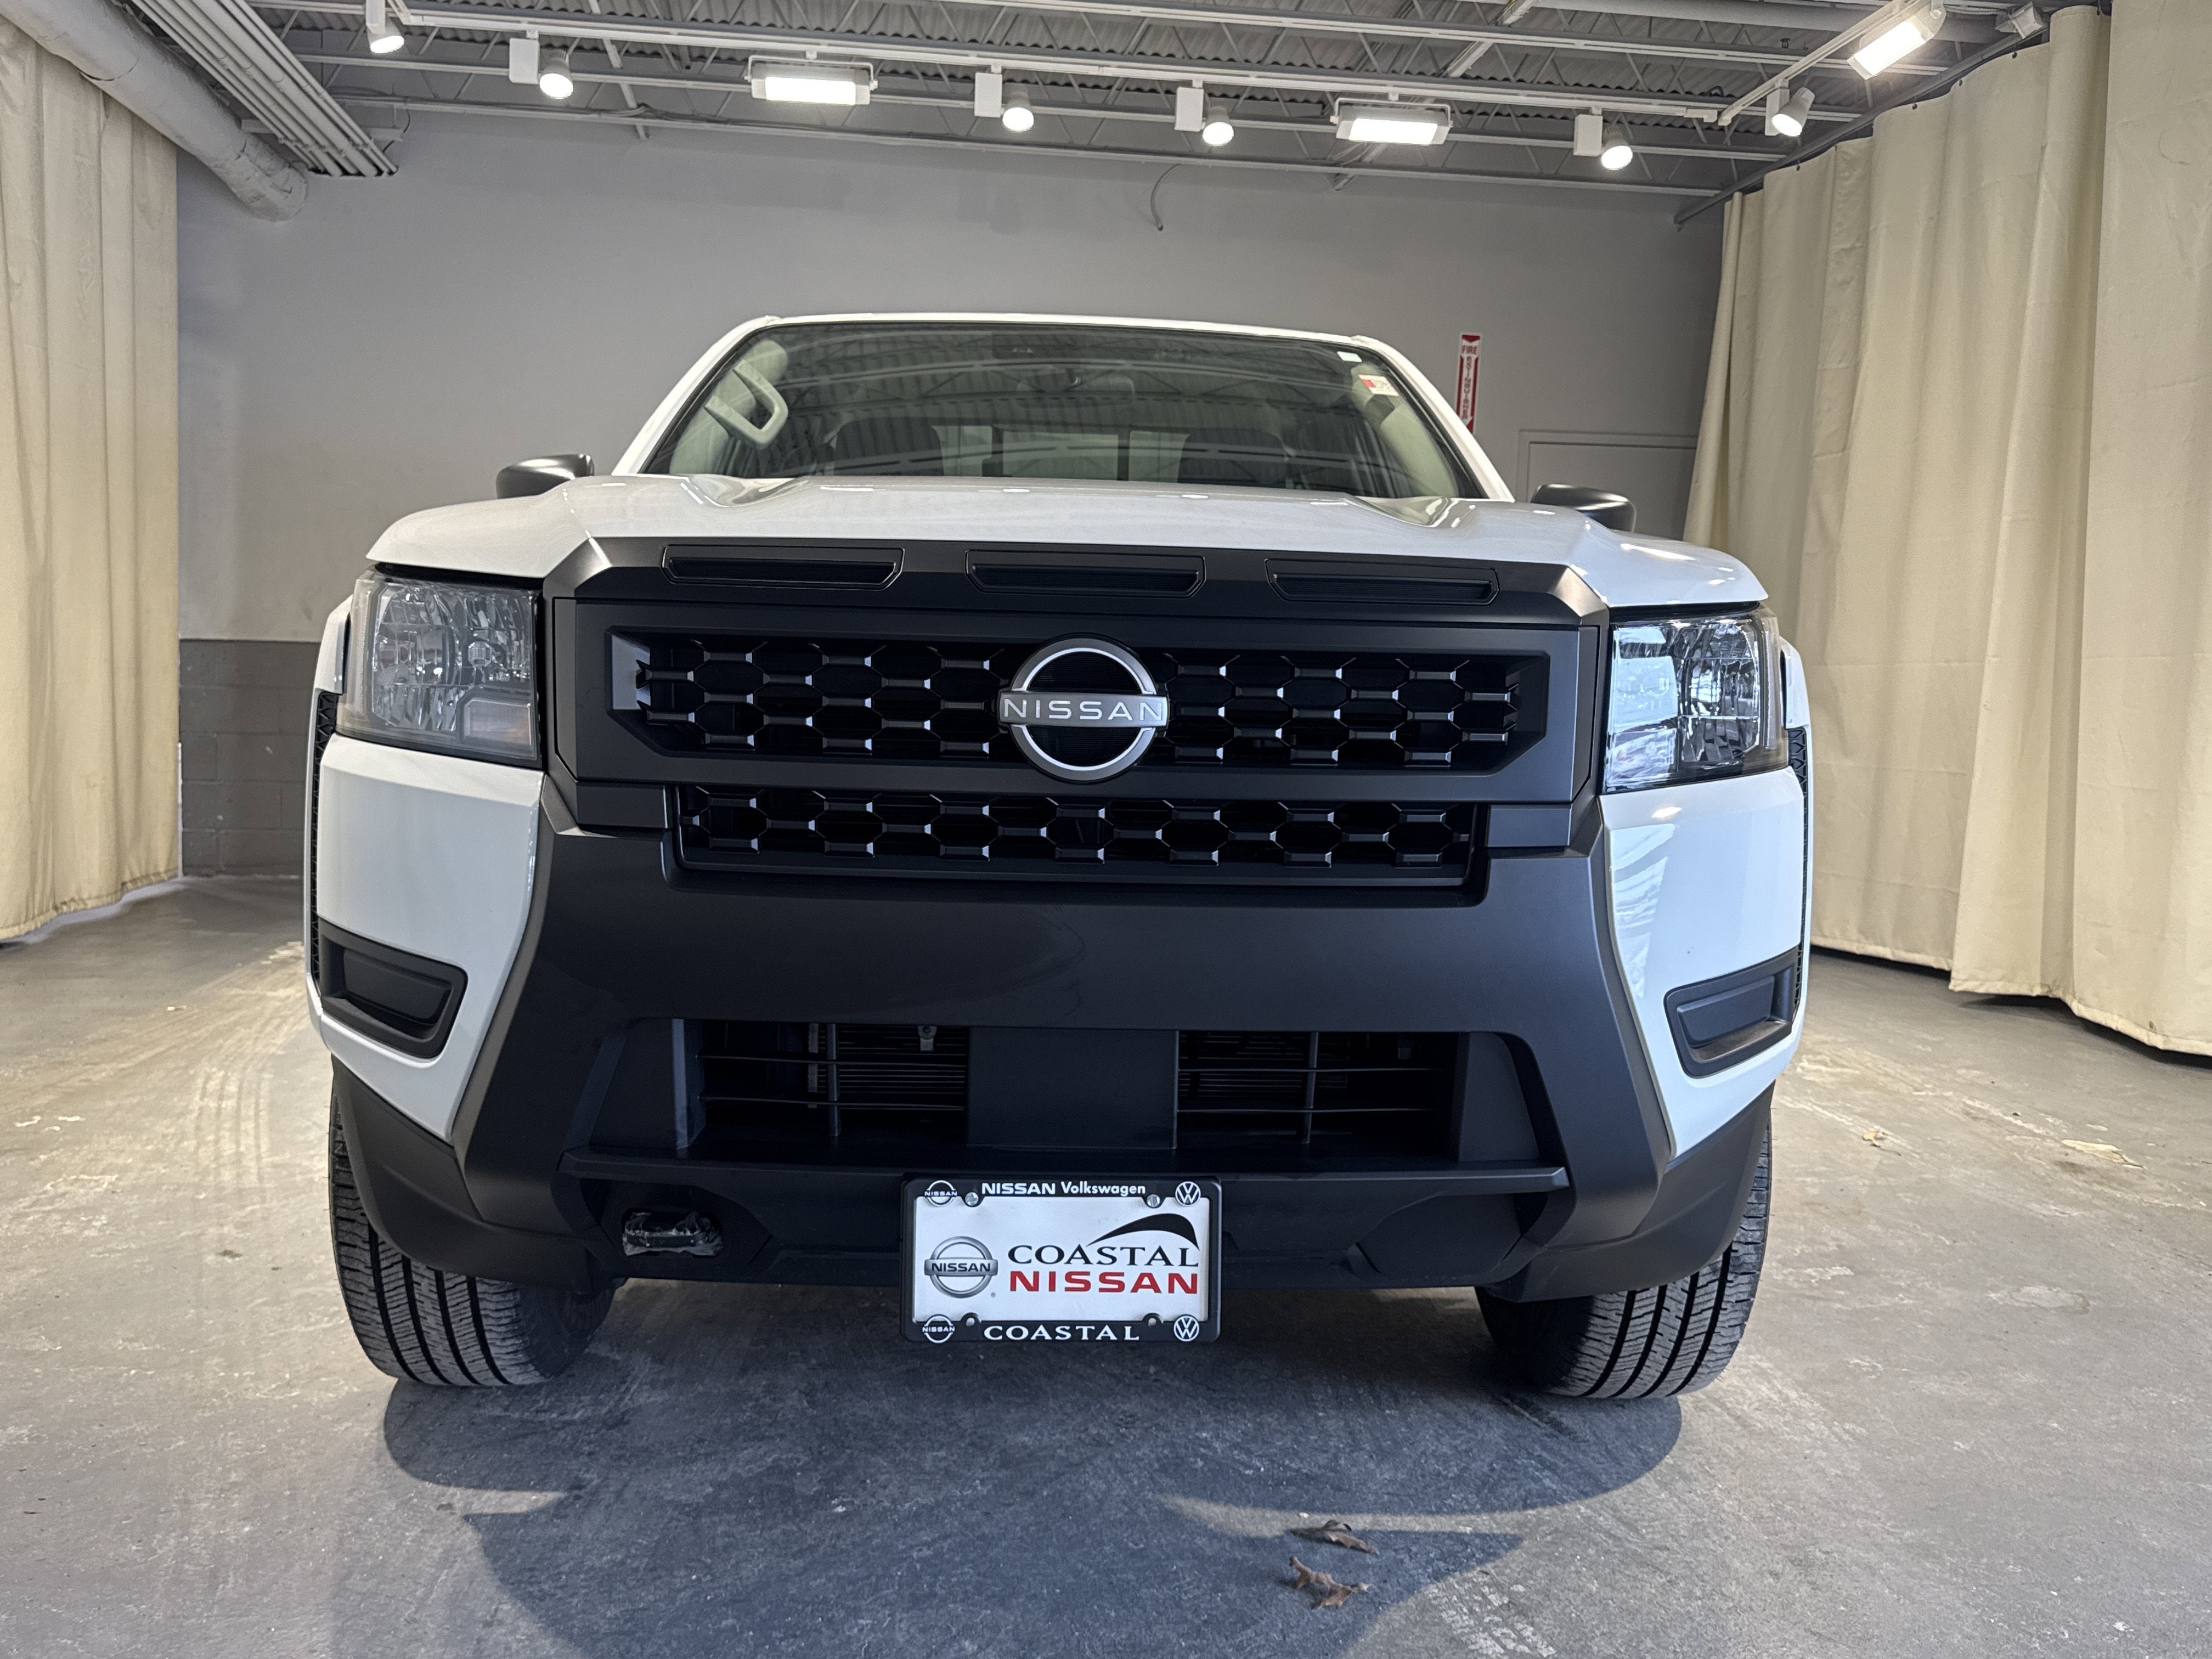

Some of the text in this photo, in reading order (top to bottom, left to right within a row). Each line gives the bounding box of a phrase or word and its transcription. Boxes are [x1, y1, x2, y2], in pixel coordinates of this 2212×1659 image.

[1462, 345, 1477, 354] FIRE
[1003, 698, 1163, 720] NISSAN
[981, 1181, 1146, 1197] NISSAN Volkswagen
[1008, 1244, 1199, 1267] COASTAL
[932, 1262, 991, 1272] NISSAN
[1009, 1271, 1198, 1294] NISSAN
[984, 1324, 1139, 1341] COASTAL
